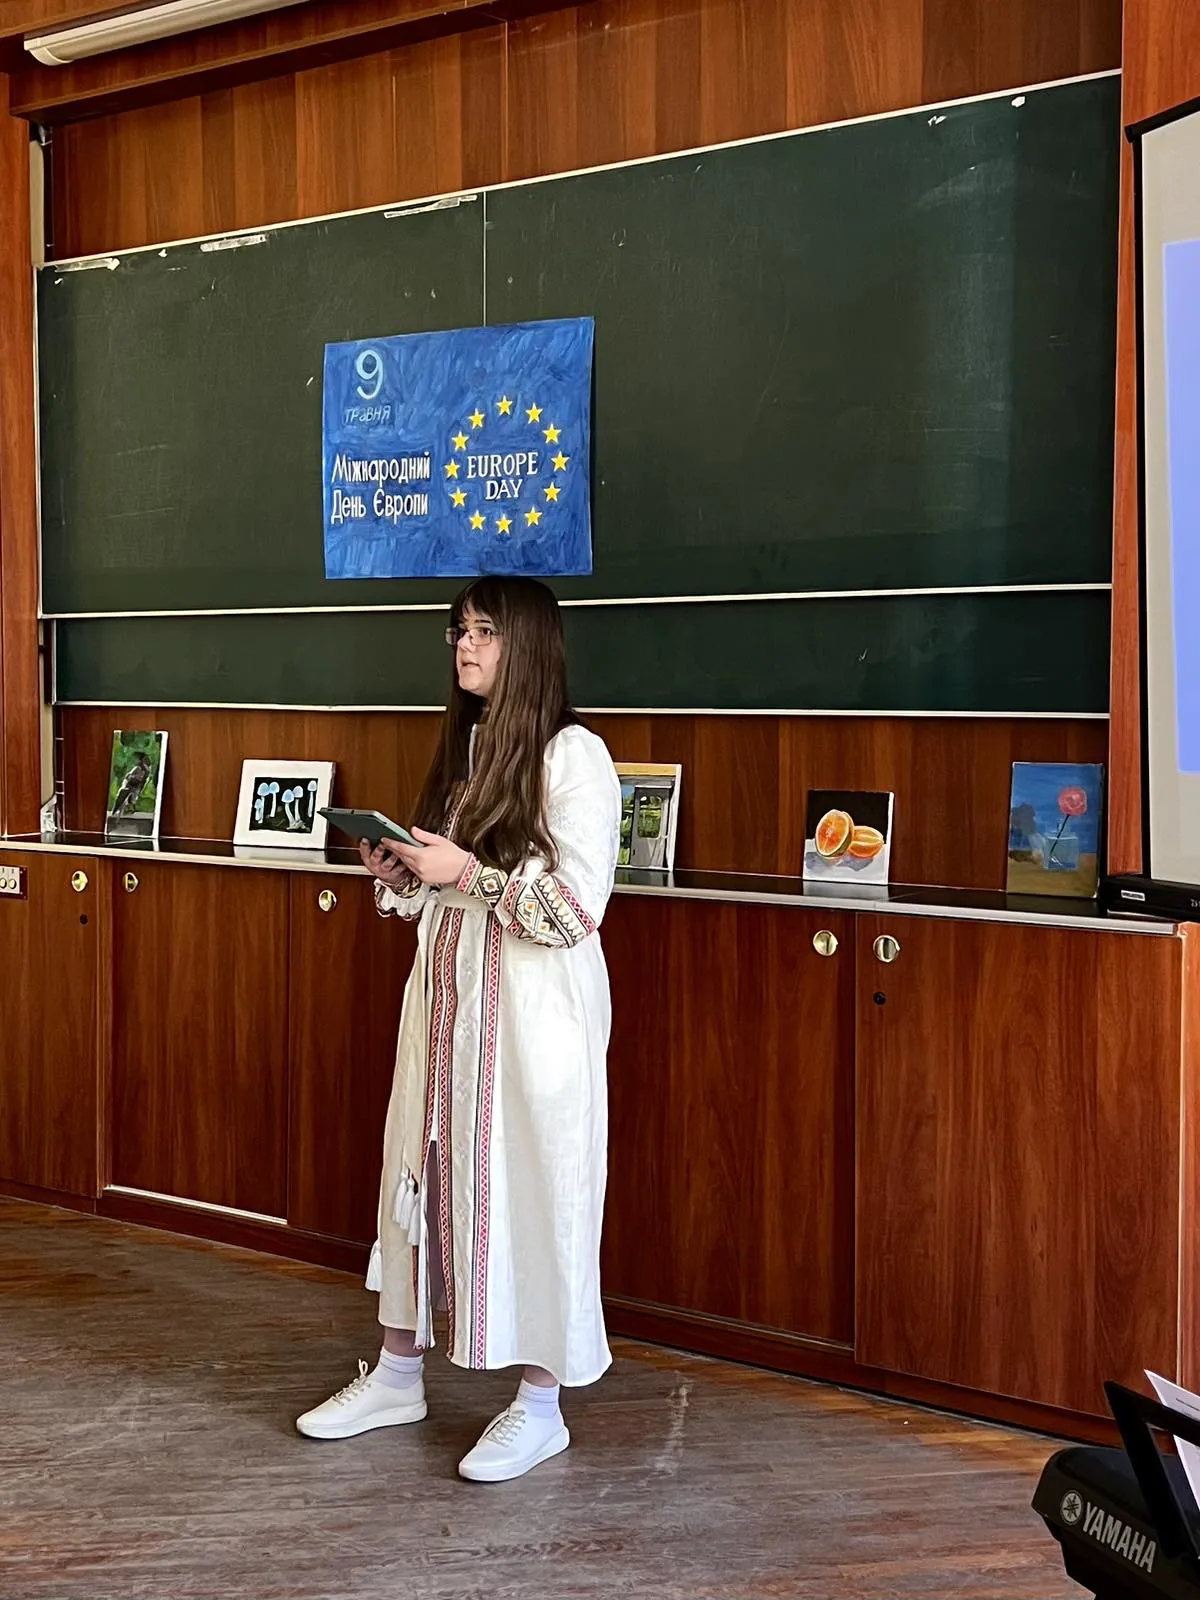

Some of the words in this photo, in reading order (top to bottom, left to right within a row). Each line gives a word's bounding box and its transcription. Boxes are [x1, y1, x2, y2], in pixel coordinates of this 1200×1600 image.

[356, 350, 384, 399] 9
[331, 452, 430, 487] Міжнародний
[466, 452, 538, 479] EUROPE
[331, 489, 366, 524] День
[374, 488, 429, 524] Європи
[485, 479, 523, 500] DAY
[1083, 1502, 1157, 1573] YAMAHA
